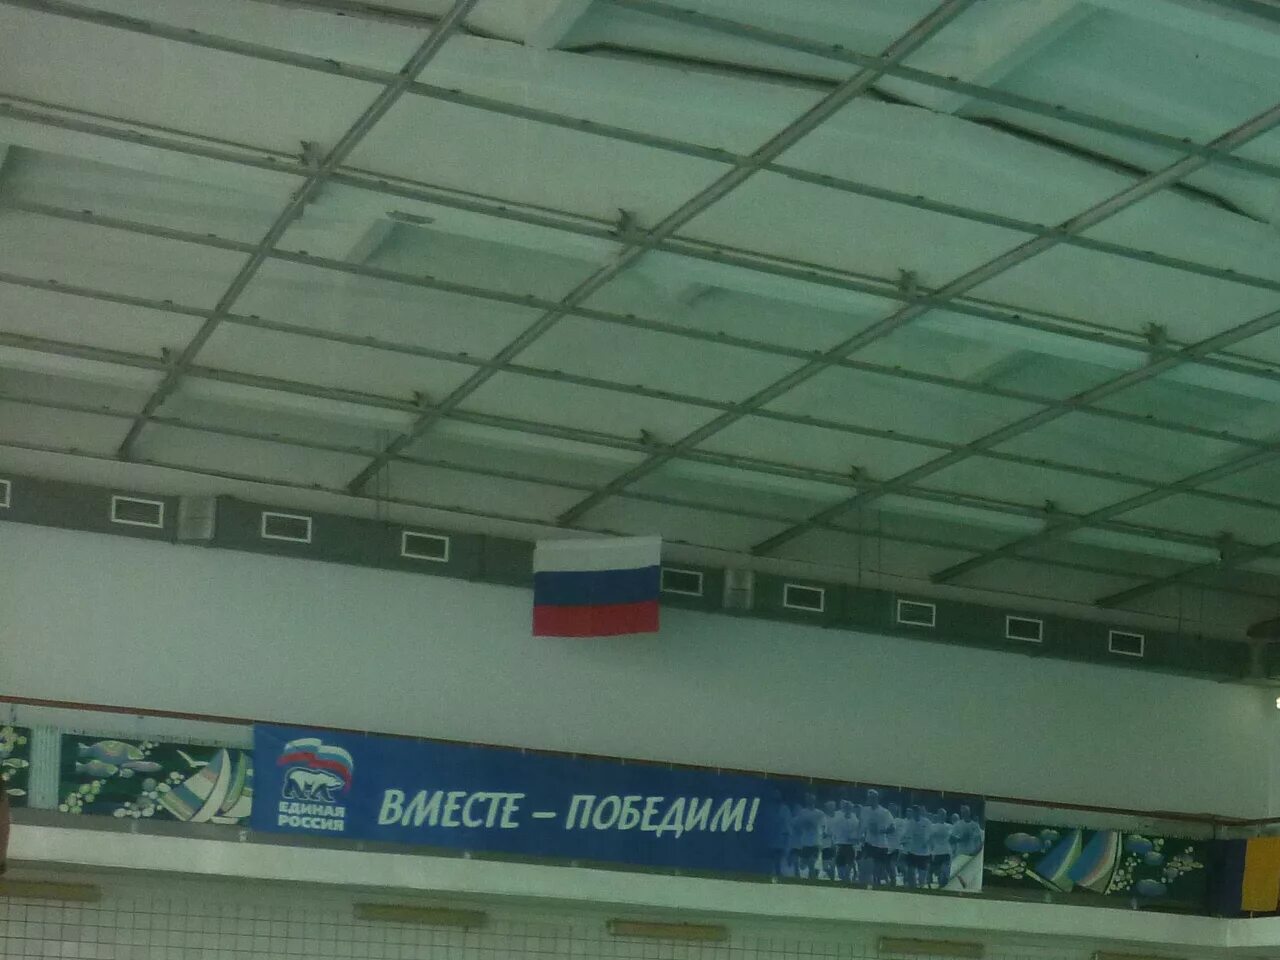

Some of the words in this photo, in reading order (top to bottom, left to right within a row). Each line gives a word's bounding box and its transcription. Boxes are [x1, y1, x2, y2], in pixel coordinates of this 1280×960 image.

[278, 801, 345, 818] ЕДИНАЯ
[377, 788, 526, 829] ВМЕСТЕ
[565, 793, 761, 839] ПОБЕДИМ!
[277, 814, 345, 831] РОССИЯ
